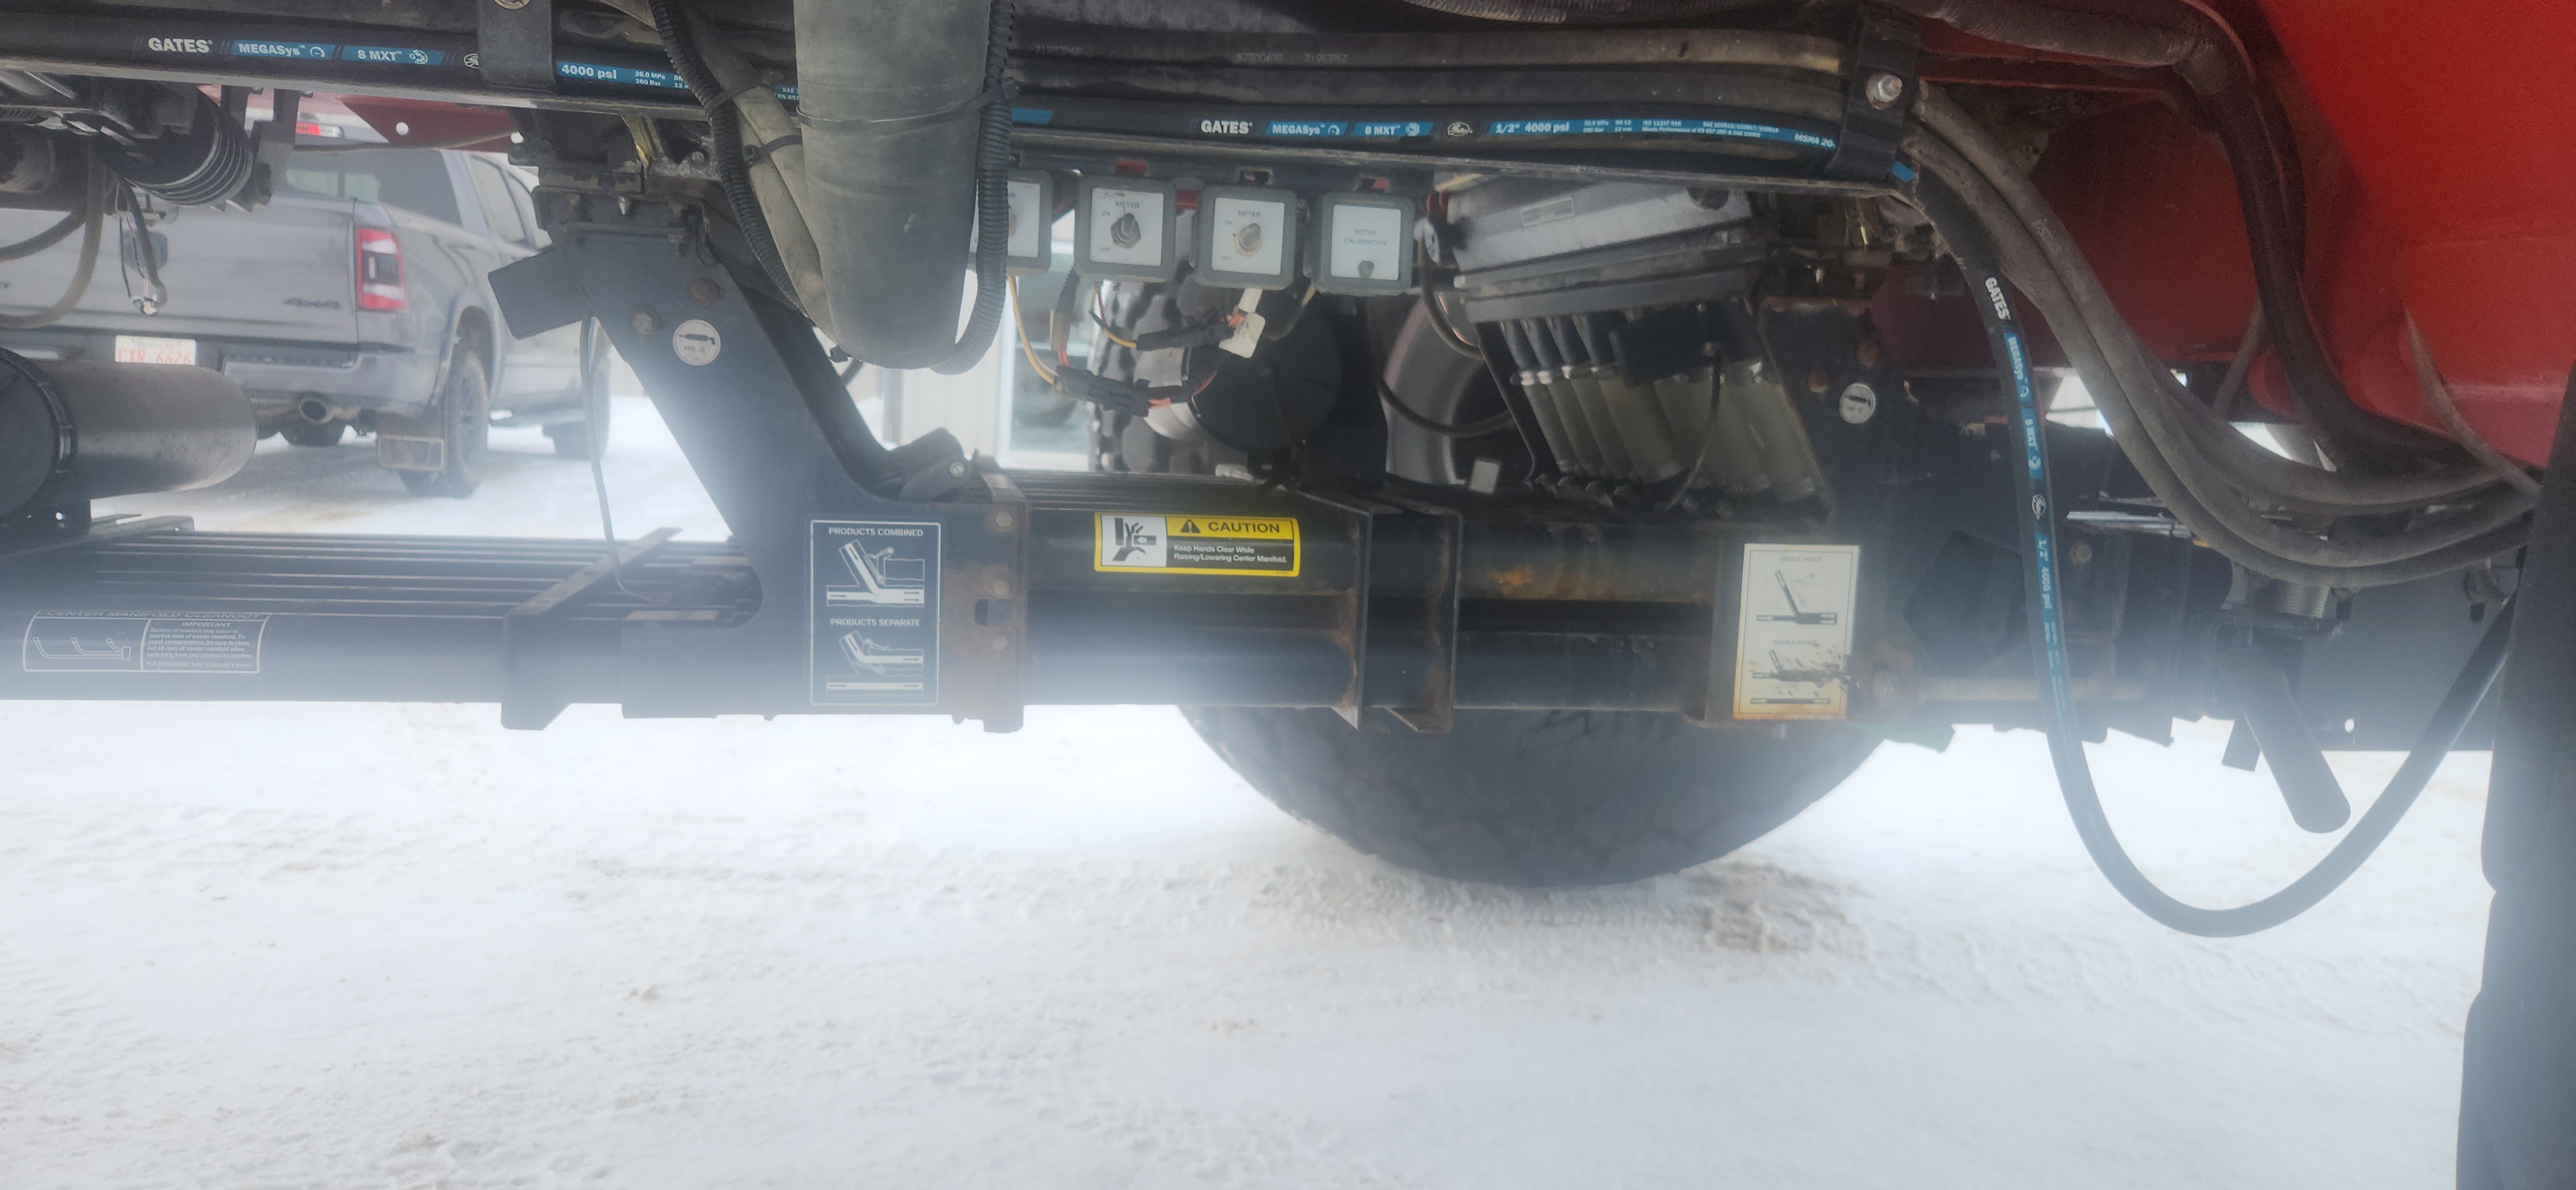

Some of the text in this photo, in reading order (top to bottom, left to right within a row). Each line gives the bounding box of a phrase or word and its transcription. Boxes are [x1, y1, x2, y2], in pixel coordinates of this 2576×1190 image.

[357, 50, 366, 59] 8
[562, 64, 617, 79] 4000 psi
[1365, 126, 1372, 135] 8
[1524, 122, 1551, 133] 4000
[1553, 122, 1570, 133] psi
[1343, 237, 1387, 246] CALIBRATION
[829, 527, 923, 537] PRODUCTS COMBINED
[1208, 522, 1280, 533] CAUTION
[1174, 545, 1192, 553] Keep
[1174, 553, 1232, 562] Raising/Lowering
[830, 618, 921, 627] PRODUCTS SEPARATE
